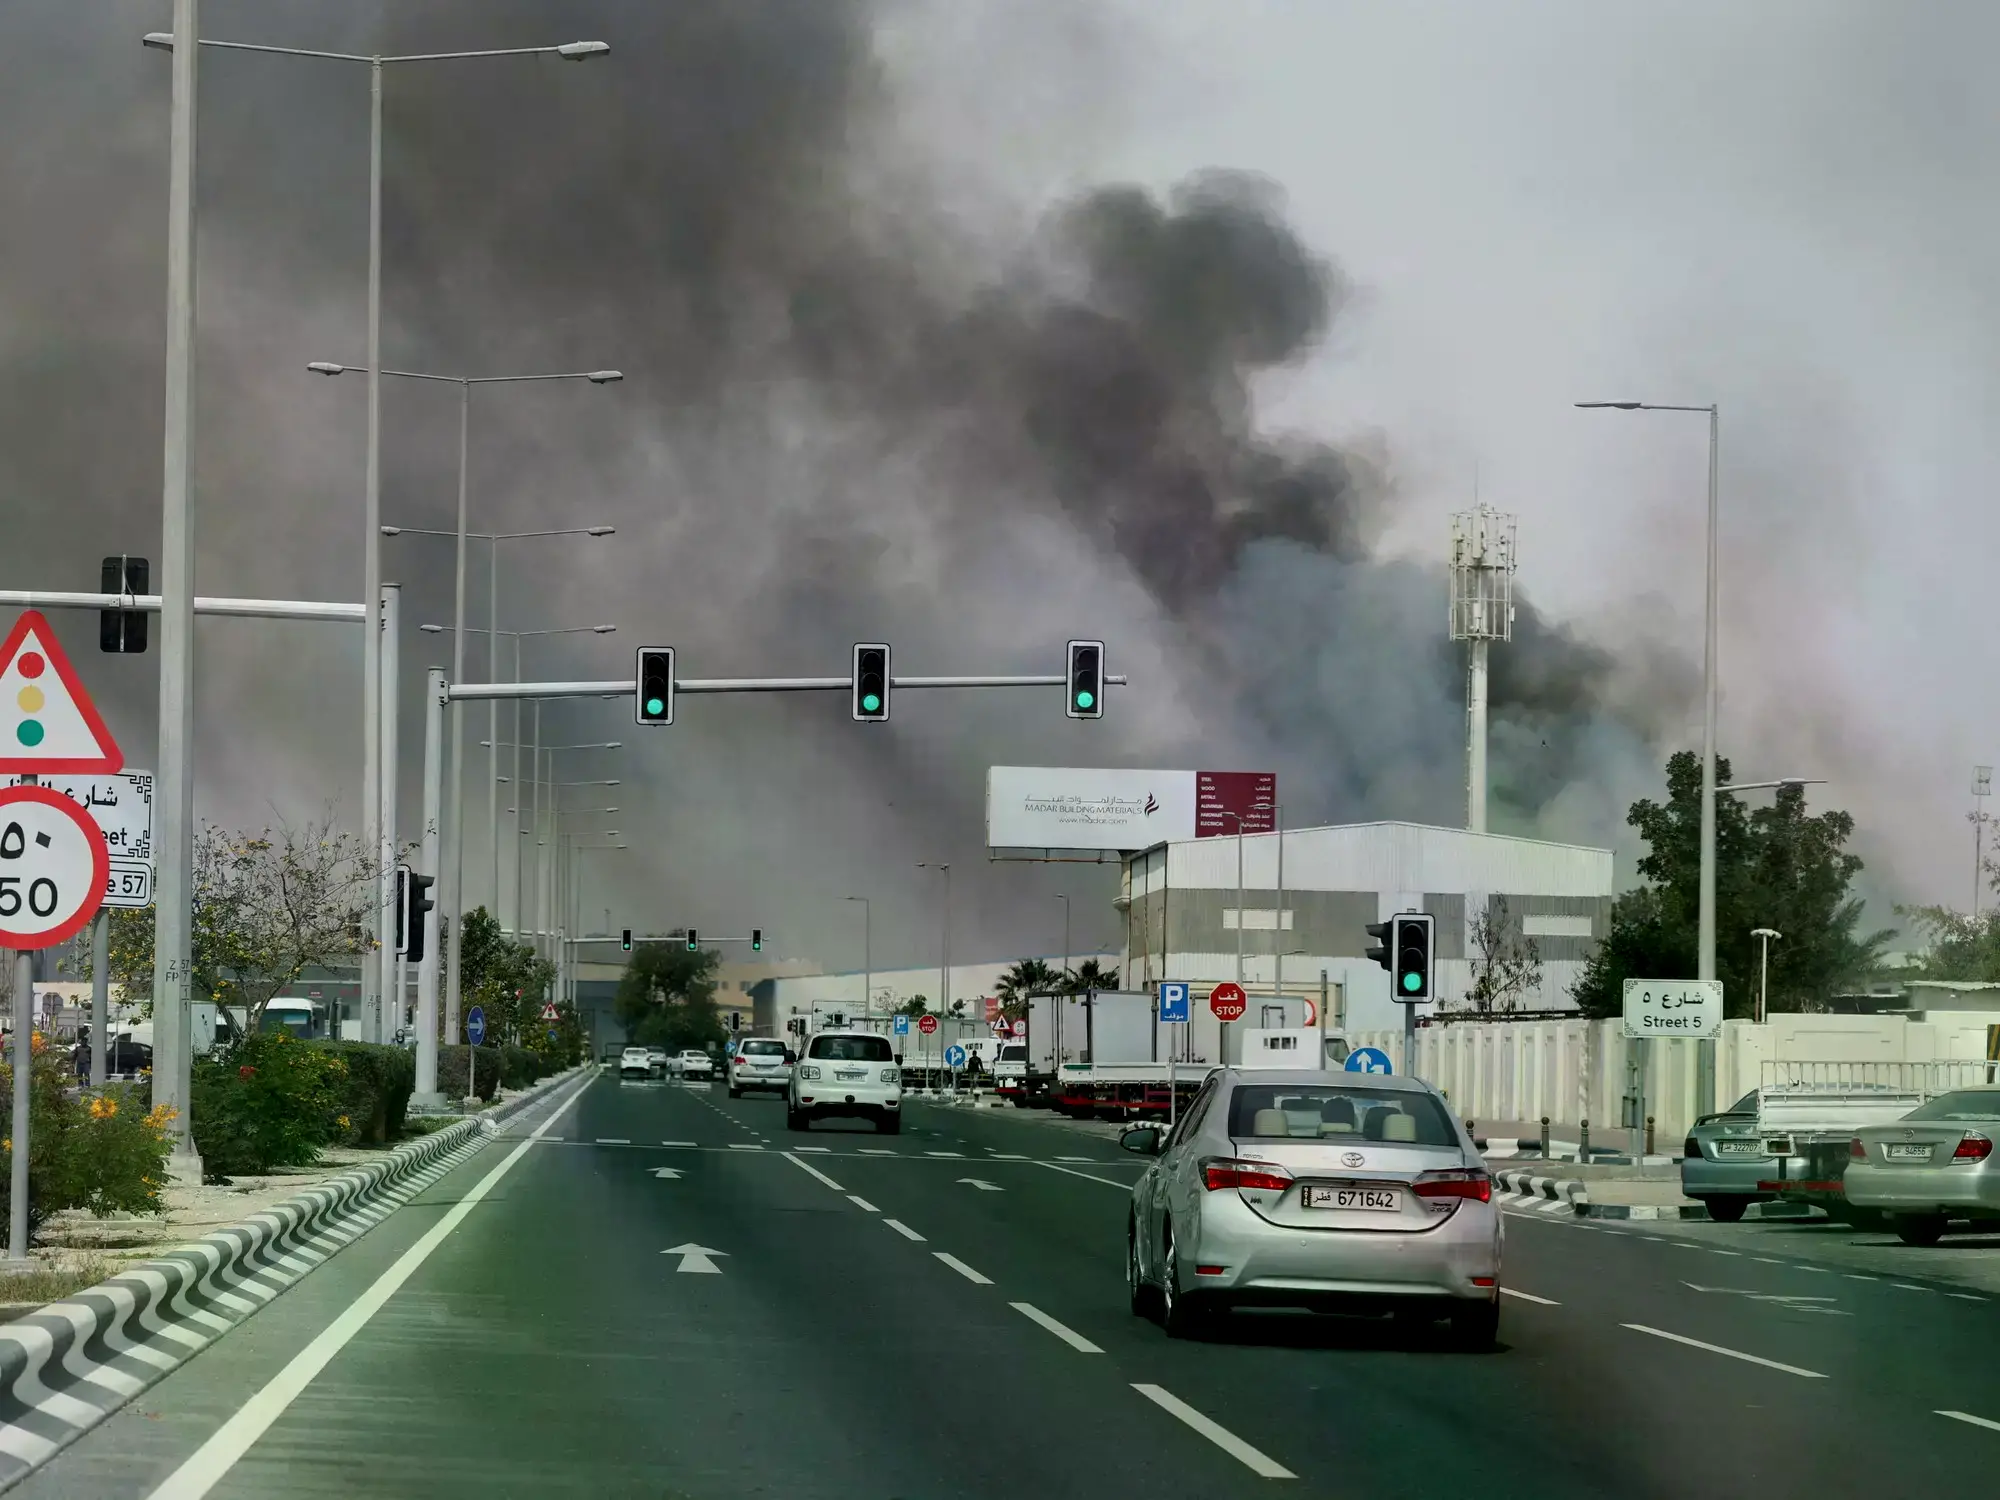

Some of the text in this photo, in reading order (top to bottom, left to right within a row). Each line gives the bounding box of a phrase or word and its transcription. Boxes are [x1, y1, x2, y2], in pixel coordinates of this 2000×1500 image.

[1024, 804, 1142, 814] MADAR BUILDING MATERIALS
[101, 827, 128, 847] eet
[0, 877, 58, 918] 50
[1166, 986, 1183, 1009] P
[1218, 990, 1238, 1000] قف
[1643, 992, 1704, 1009] شارع ٥
[1216, 1006, 1243, 1015] STOP
[896, 1017, 906, 1028] P
[1643, 1015, 1702, 1028] Street 5
[1313, 1190, 1394, 1208] قطر 671642
